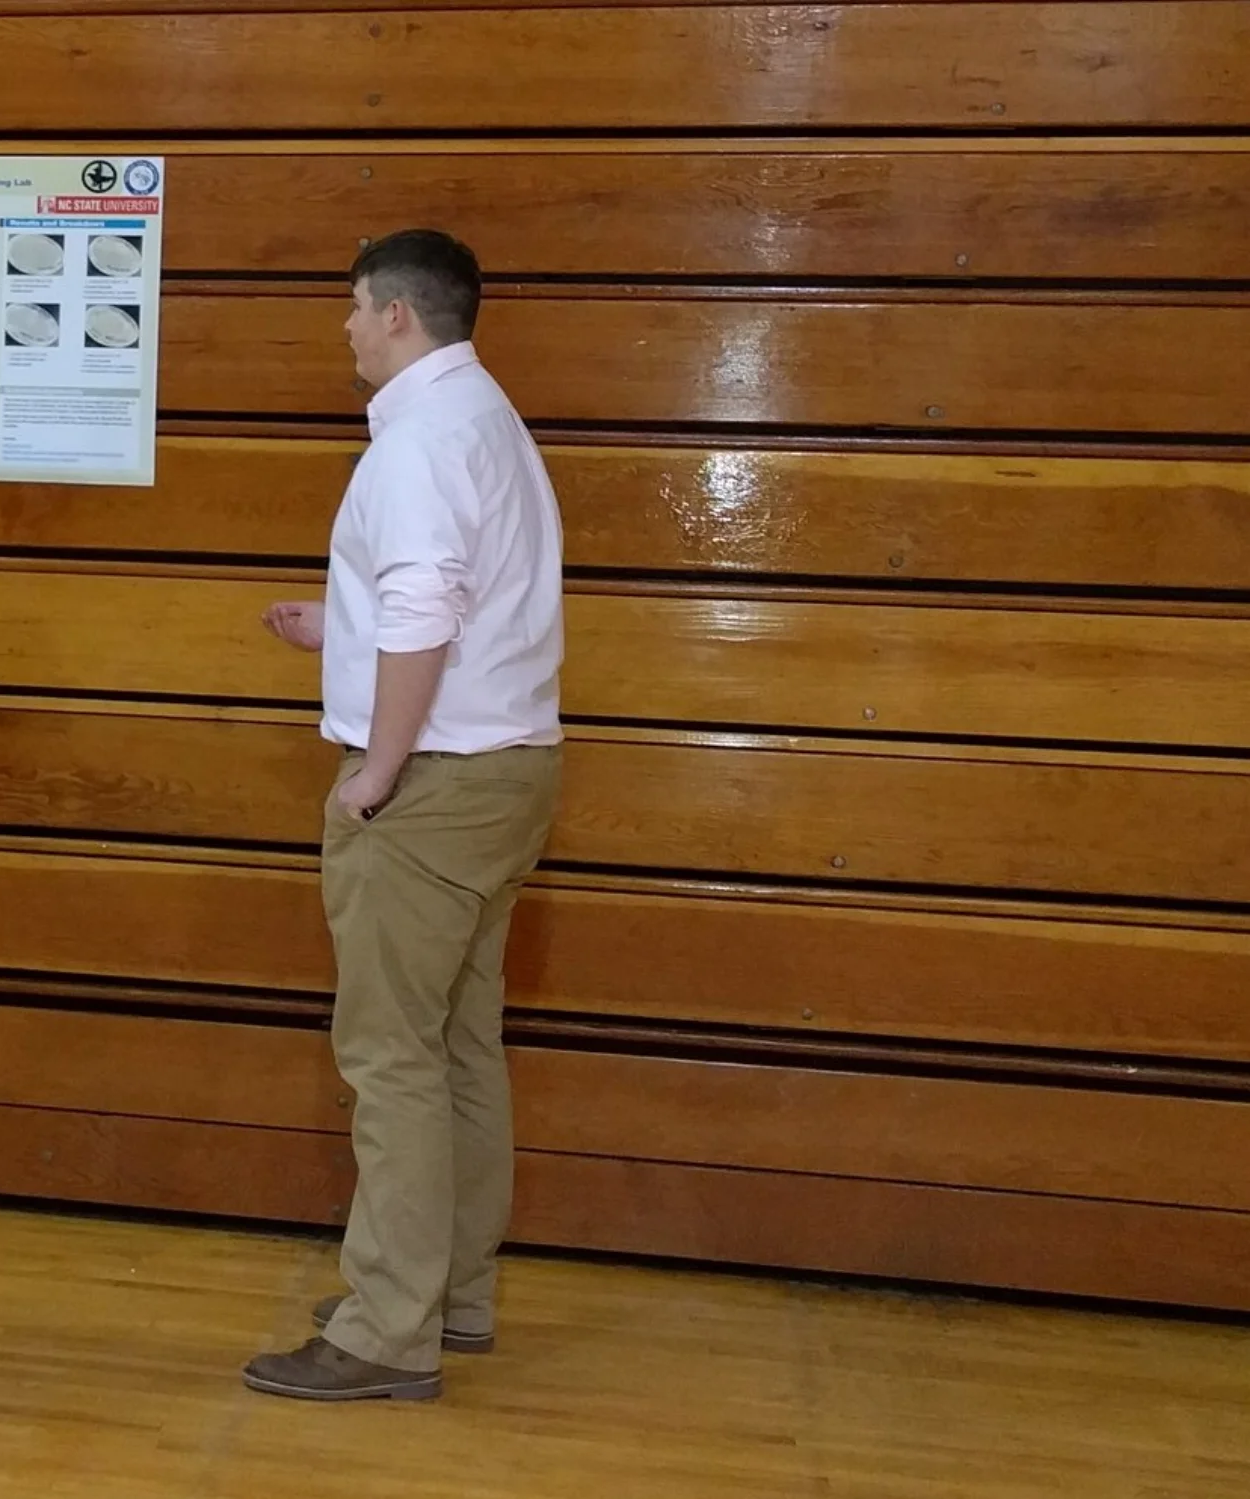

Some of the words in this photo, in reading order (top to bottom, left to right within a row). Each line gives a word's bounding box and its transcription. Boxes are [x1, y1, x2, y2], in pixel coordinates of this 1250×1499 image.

[14, 178, 32, 187] Lab
[58, 201, 72, 211] NC
[74, 201, 101, 211] STATE
[103, 201, 158, 212] UNIVERSITY
